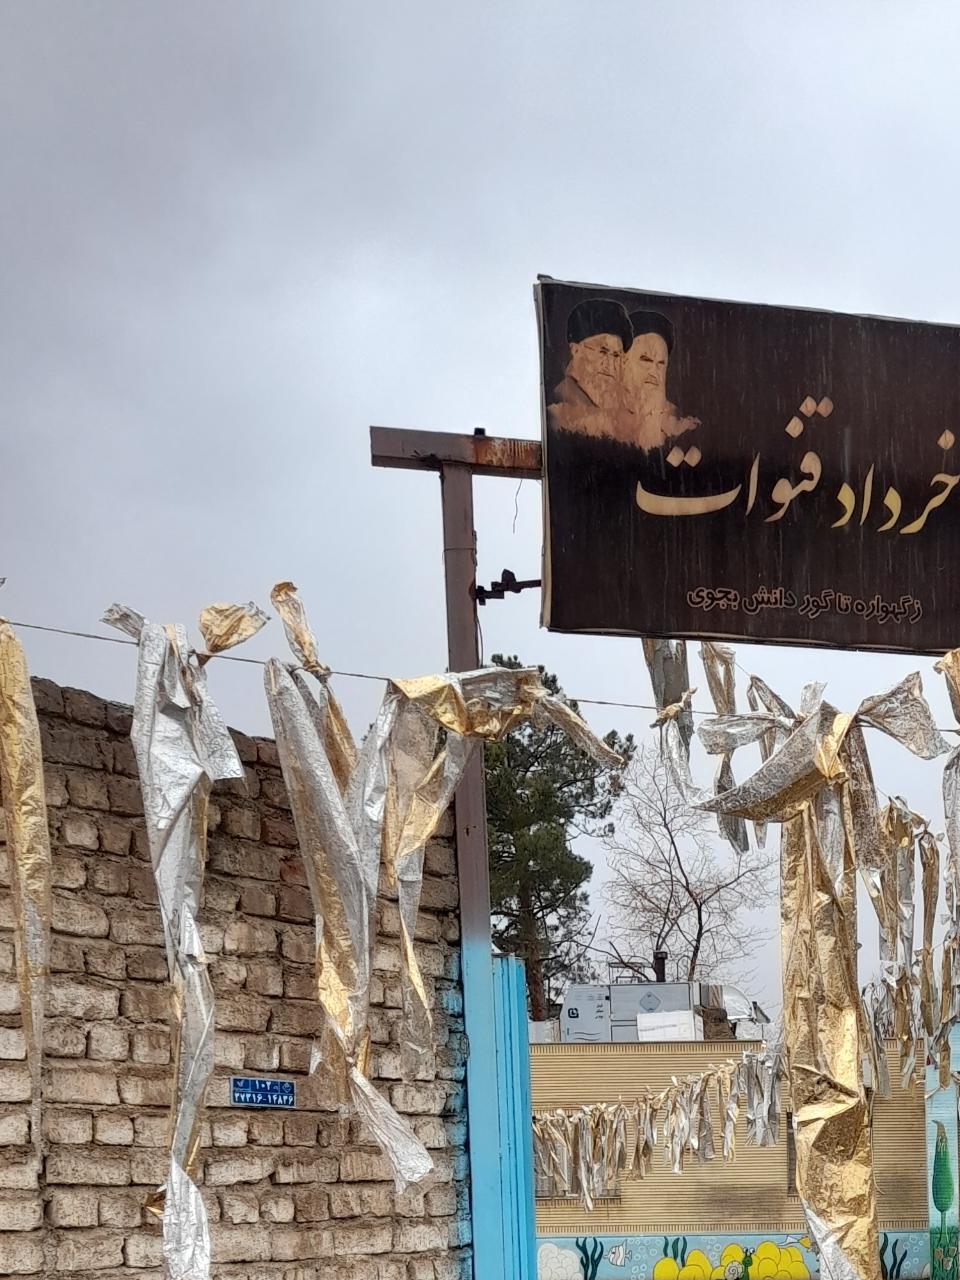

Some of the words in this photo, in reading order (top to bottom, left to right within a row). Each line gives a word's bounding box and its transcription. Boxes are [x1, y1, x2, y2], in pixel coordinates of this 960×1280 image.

[635, 395, 834, 523] قنوات
[830, 428, 960, 535] خرداد
[686, 586, 740, 611] بجوی
[741, 585, 798, 615] دانش
[798, 588, 834, 619] گور
